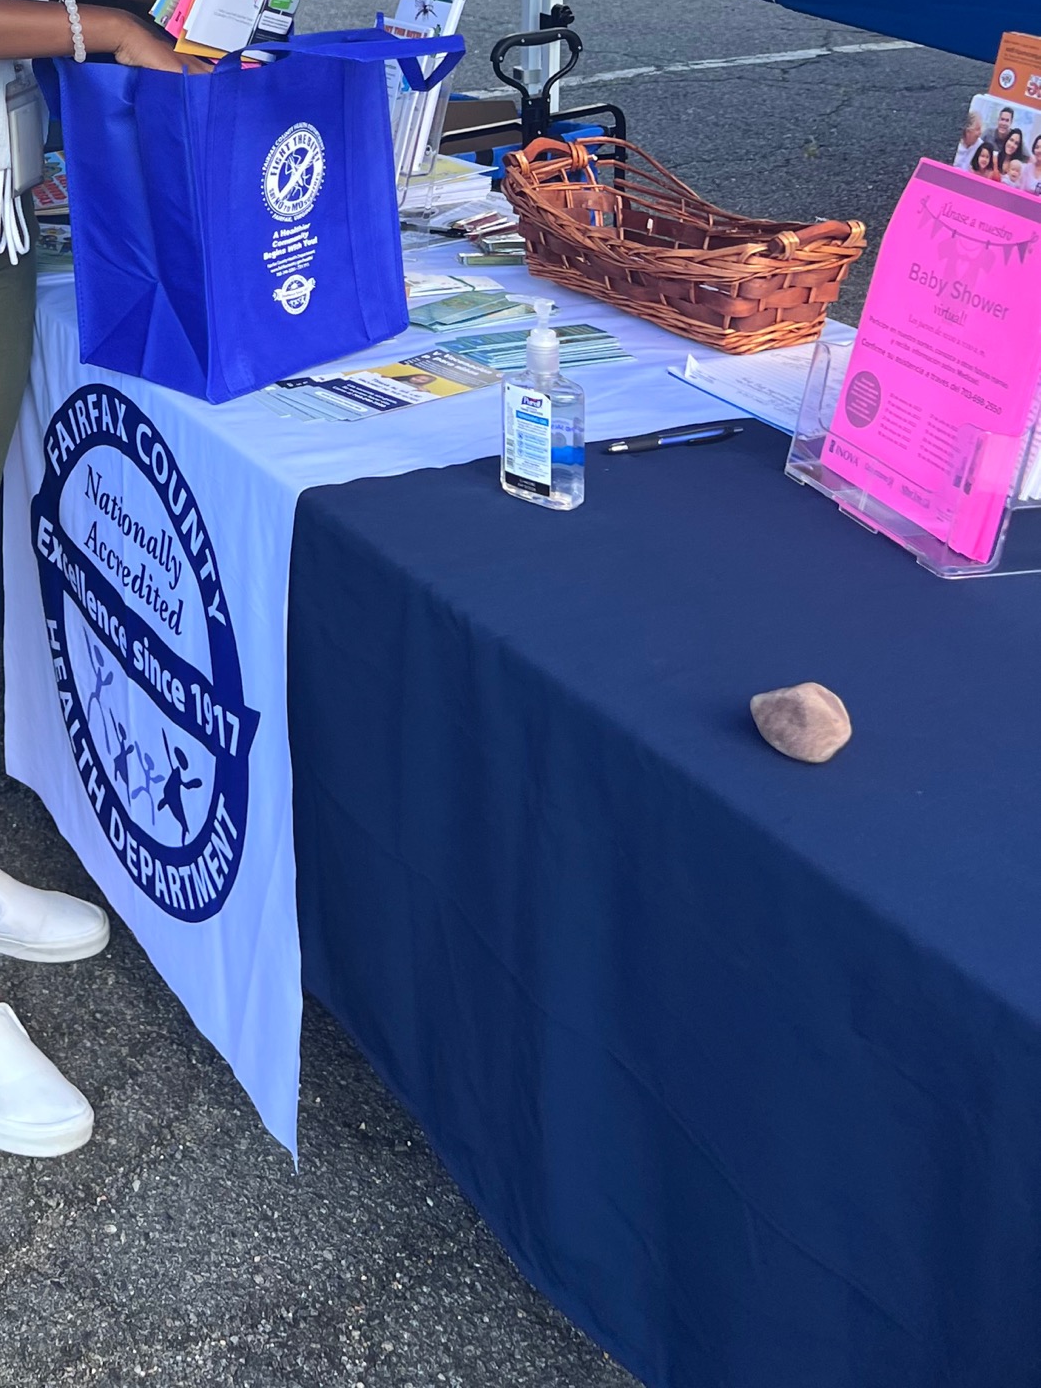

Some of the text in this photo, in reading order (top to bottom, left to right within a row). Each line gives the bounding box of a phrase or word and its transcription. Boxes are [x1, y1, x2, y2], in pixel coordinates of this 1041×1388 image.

[270, 142, 291, 176] FIGHT
[292, 133, 307, 147] THE
[273, 199, 284, 210] NO
[272, 223, 311, 239] A Healthier
[272, 231, 309, 248] Community
[969, 218, 977, 228] a
[978, 221, 1013, 241] nuestro
[263, 248, 286, 261] Begins
[287, 242, 303, 253] With
[908, 262, 1009, 321] Baby Shower
[933, 302, 968, 326] virtual!
[835, 445, 859, 467] INOVA
[46, 392, 227, 628] FAIRFAX COUNTY
[84, 464, 182, 591] Nationally
[84, 521, 184, 636] Accredited
[37, 515, 241, 757] Excellence since 1917
[46, 618, 239, 911] HEALTH DEPARTMENT
